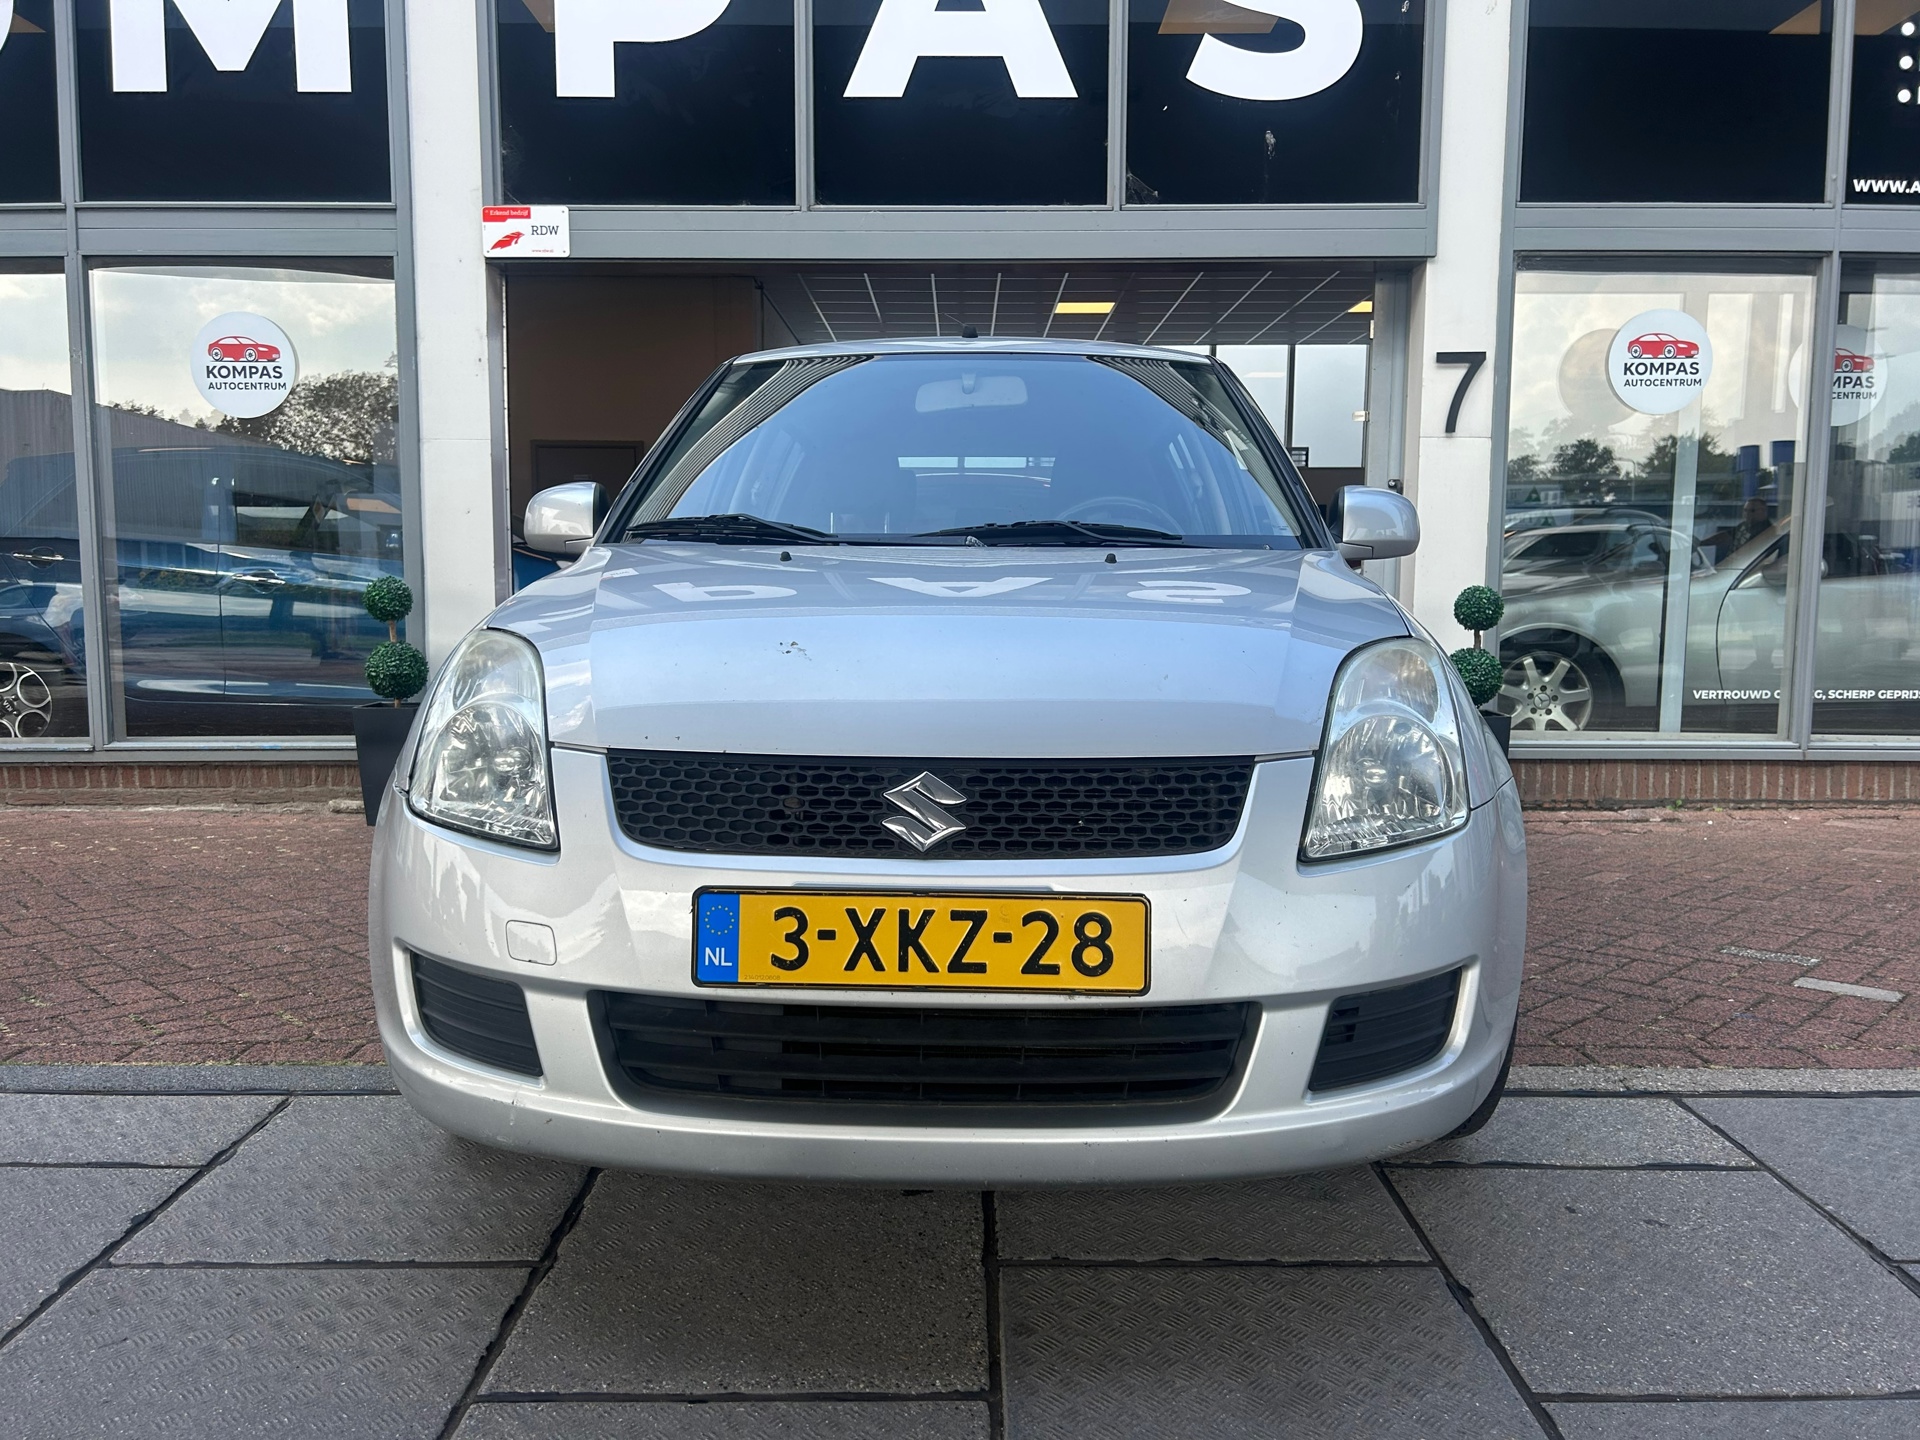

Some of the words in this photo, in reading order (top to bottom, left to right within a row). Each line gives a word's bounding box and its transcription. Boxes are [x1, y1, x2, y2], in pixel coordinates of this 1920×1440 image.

[510, 209, 529, 217] bedrijf
[531, 225, 559, 236] RDW
[206, 365, 283, 379] KOMPAS
[1623, 362, 1700, 376] KOMPAS
[208, 381, 287, 391] AUTOCENTRUM
[1623, 378, 1702, 387] AUTOCENTRUM
[1833, 375, 1875, 389] MPAS
[1436, 351, 1487, 433] 7
[1831, 391, 1878, 400] CENTRUM
[1692, 689, 1772, 700] VERTROUWD
[1827, 689, 1876, 700] SCHERP
[1877, 689, 1920, 700] GEPRIJ
[770, 905, 1115, 978] 3-XKZ-28
[705, 946, 733, 967] NL
